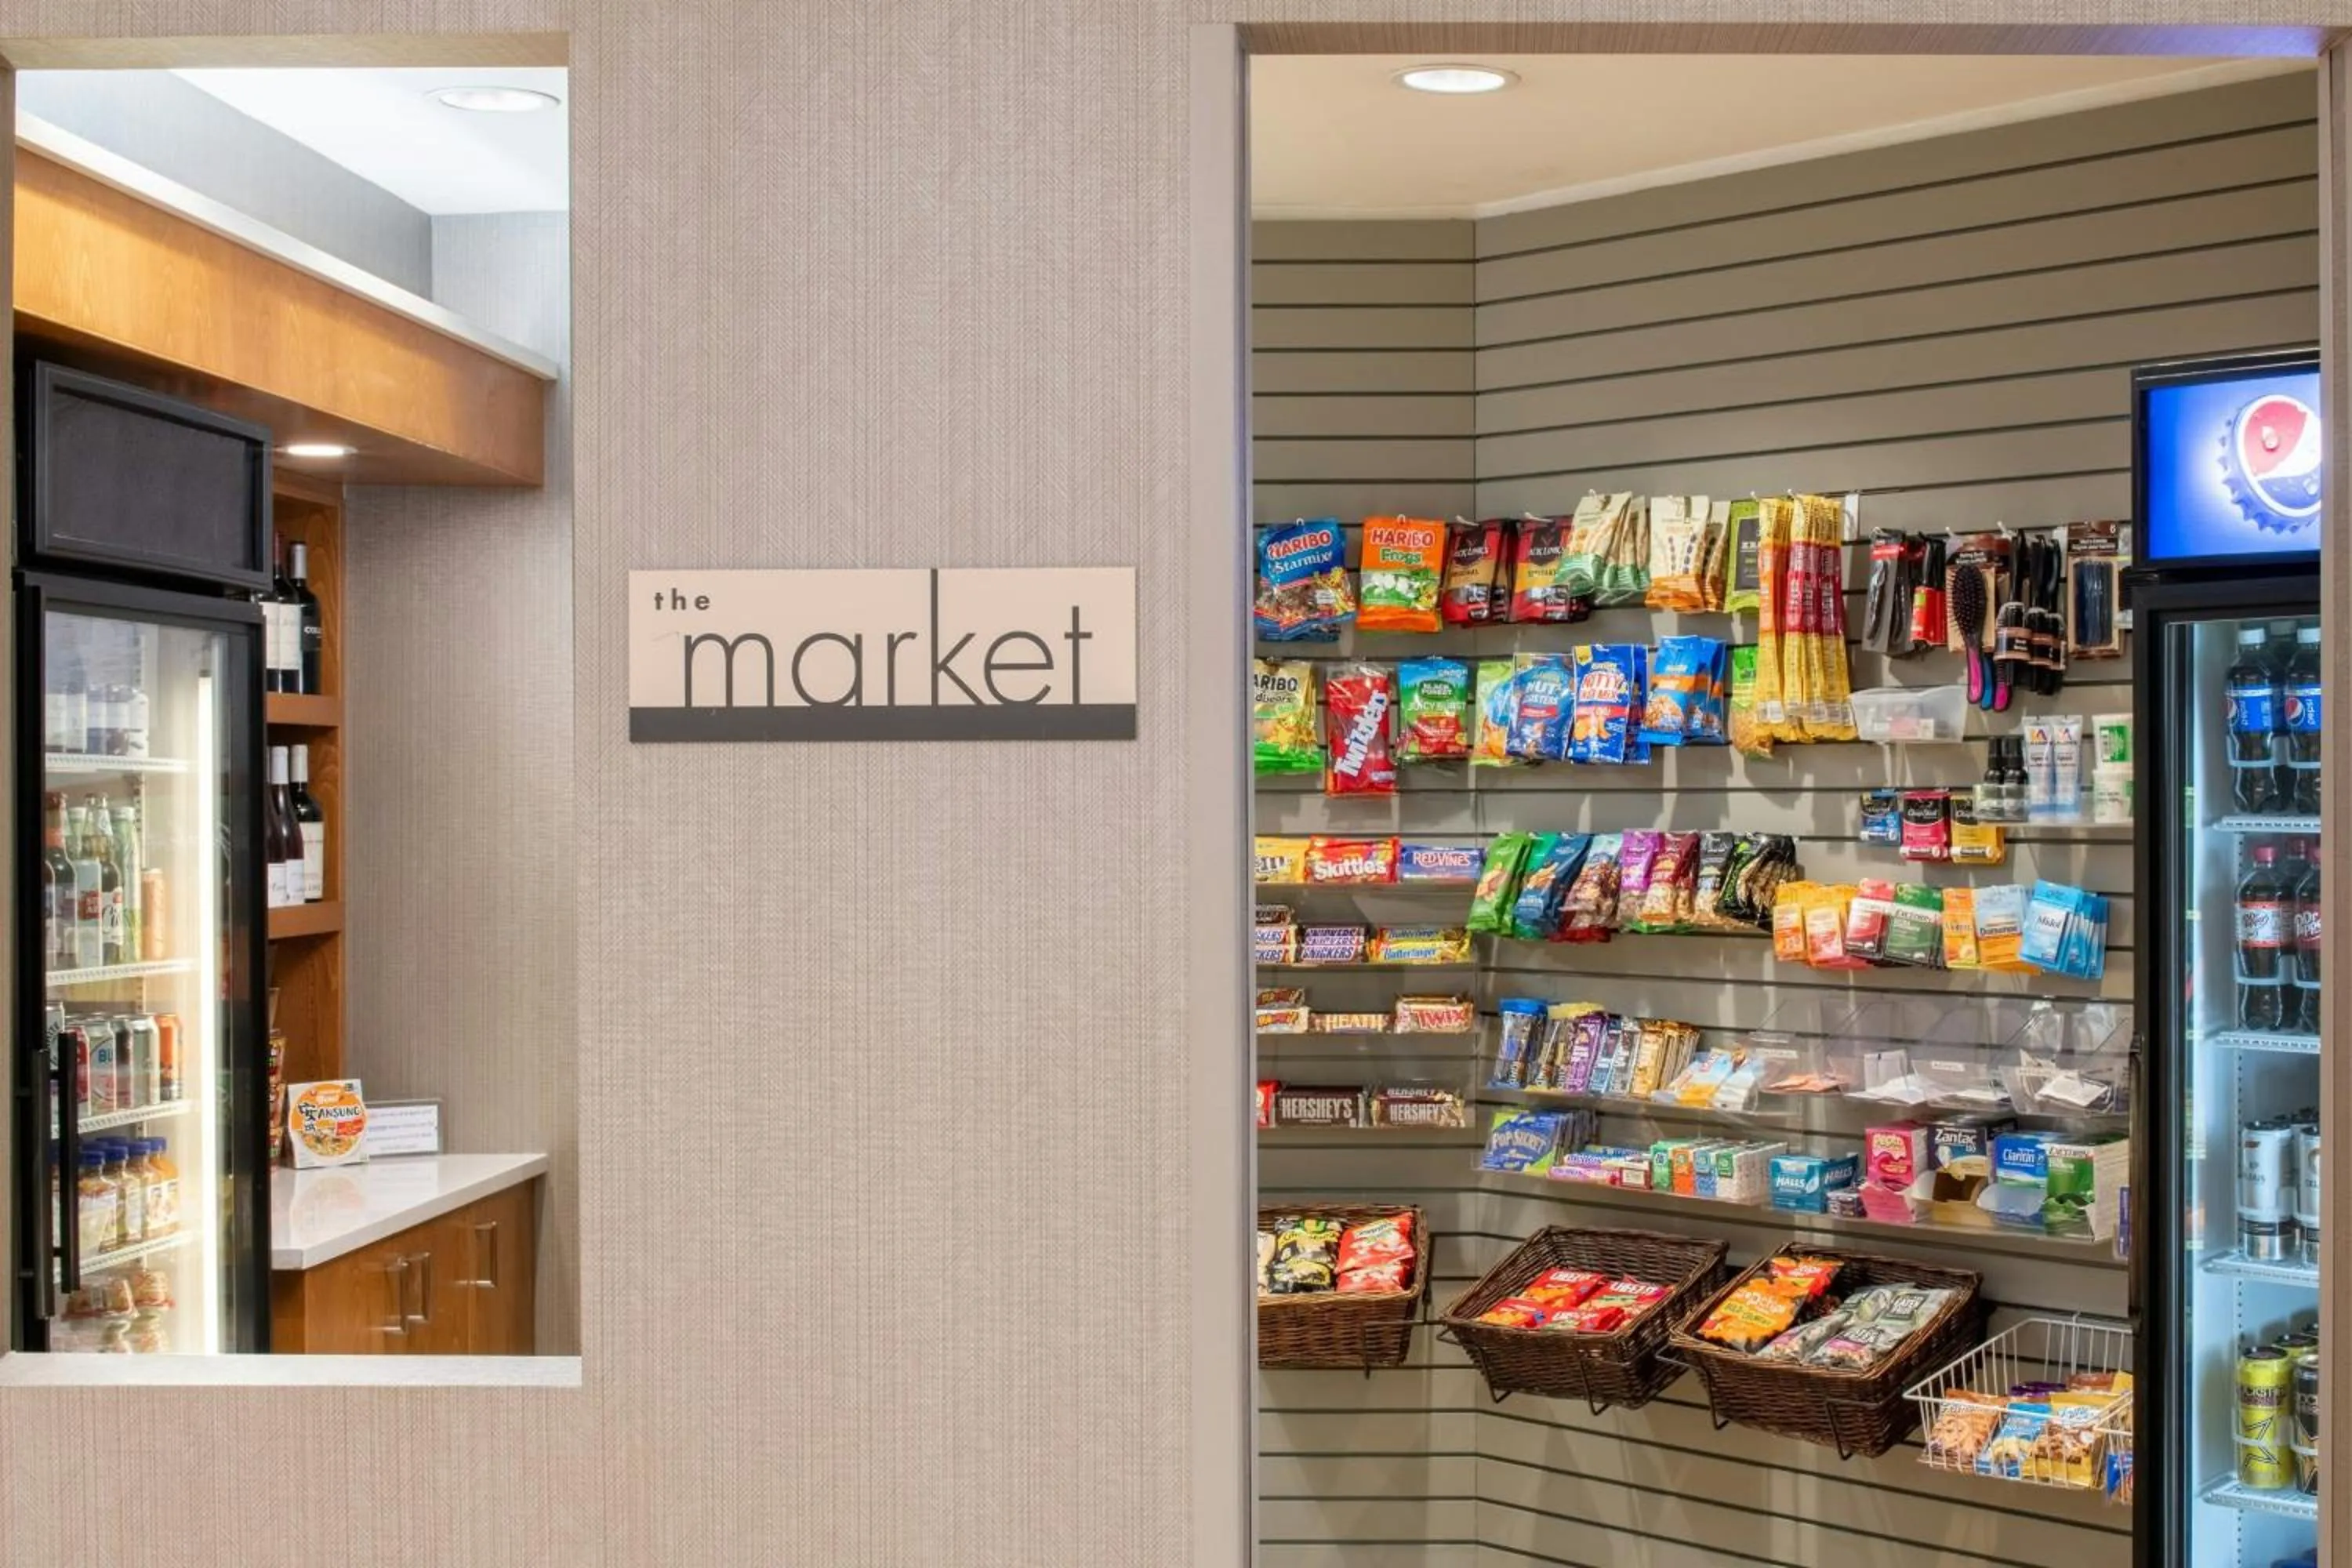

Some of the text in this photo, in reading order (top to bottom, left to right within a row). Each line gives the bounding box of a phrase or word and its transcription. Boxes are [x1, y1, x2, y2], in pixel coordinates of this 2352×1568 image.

[1268, 531, 1333, 559] HARIBO
[1371, 528, 1436, 548] HARIBO
[1271, 550, 1333, 574] Starmix
[1380, 548, 1424, 564] Frogs
[654, 588, 711, 611] the
[684, 568, 1093, 707] market
[1254, 674, 1298, 692] ARIBO
[1412, 851, 1471, 867] RED VINES
[1313, 857, 1388, 880] Skittles
[2038, 915, 2063, 929] Midol
[1302, 946, 1354, 959] SNICKERS
[1384, 947, 1438, 960] Butterfinger
[1326, 1014, 1383, 1030] HEATH
[1416, 1009, 1466, 1029] TWIX
[1282, 1098, 1352, 1120] HERSHEY'S
[1390, 1103, 1450, 1122] HERSHEY'S
[1934, 1128, 1977, 1145] Zantac
[2002, 1148, 2035, 1163] Claritin
[1776, 1177, 1806, 1189] HALLS
